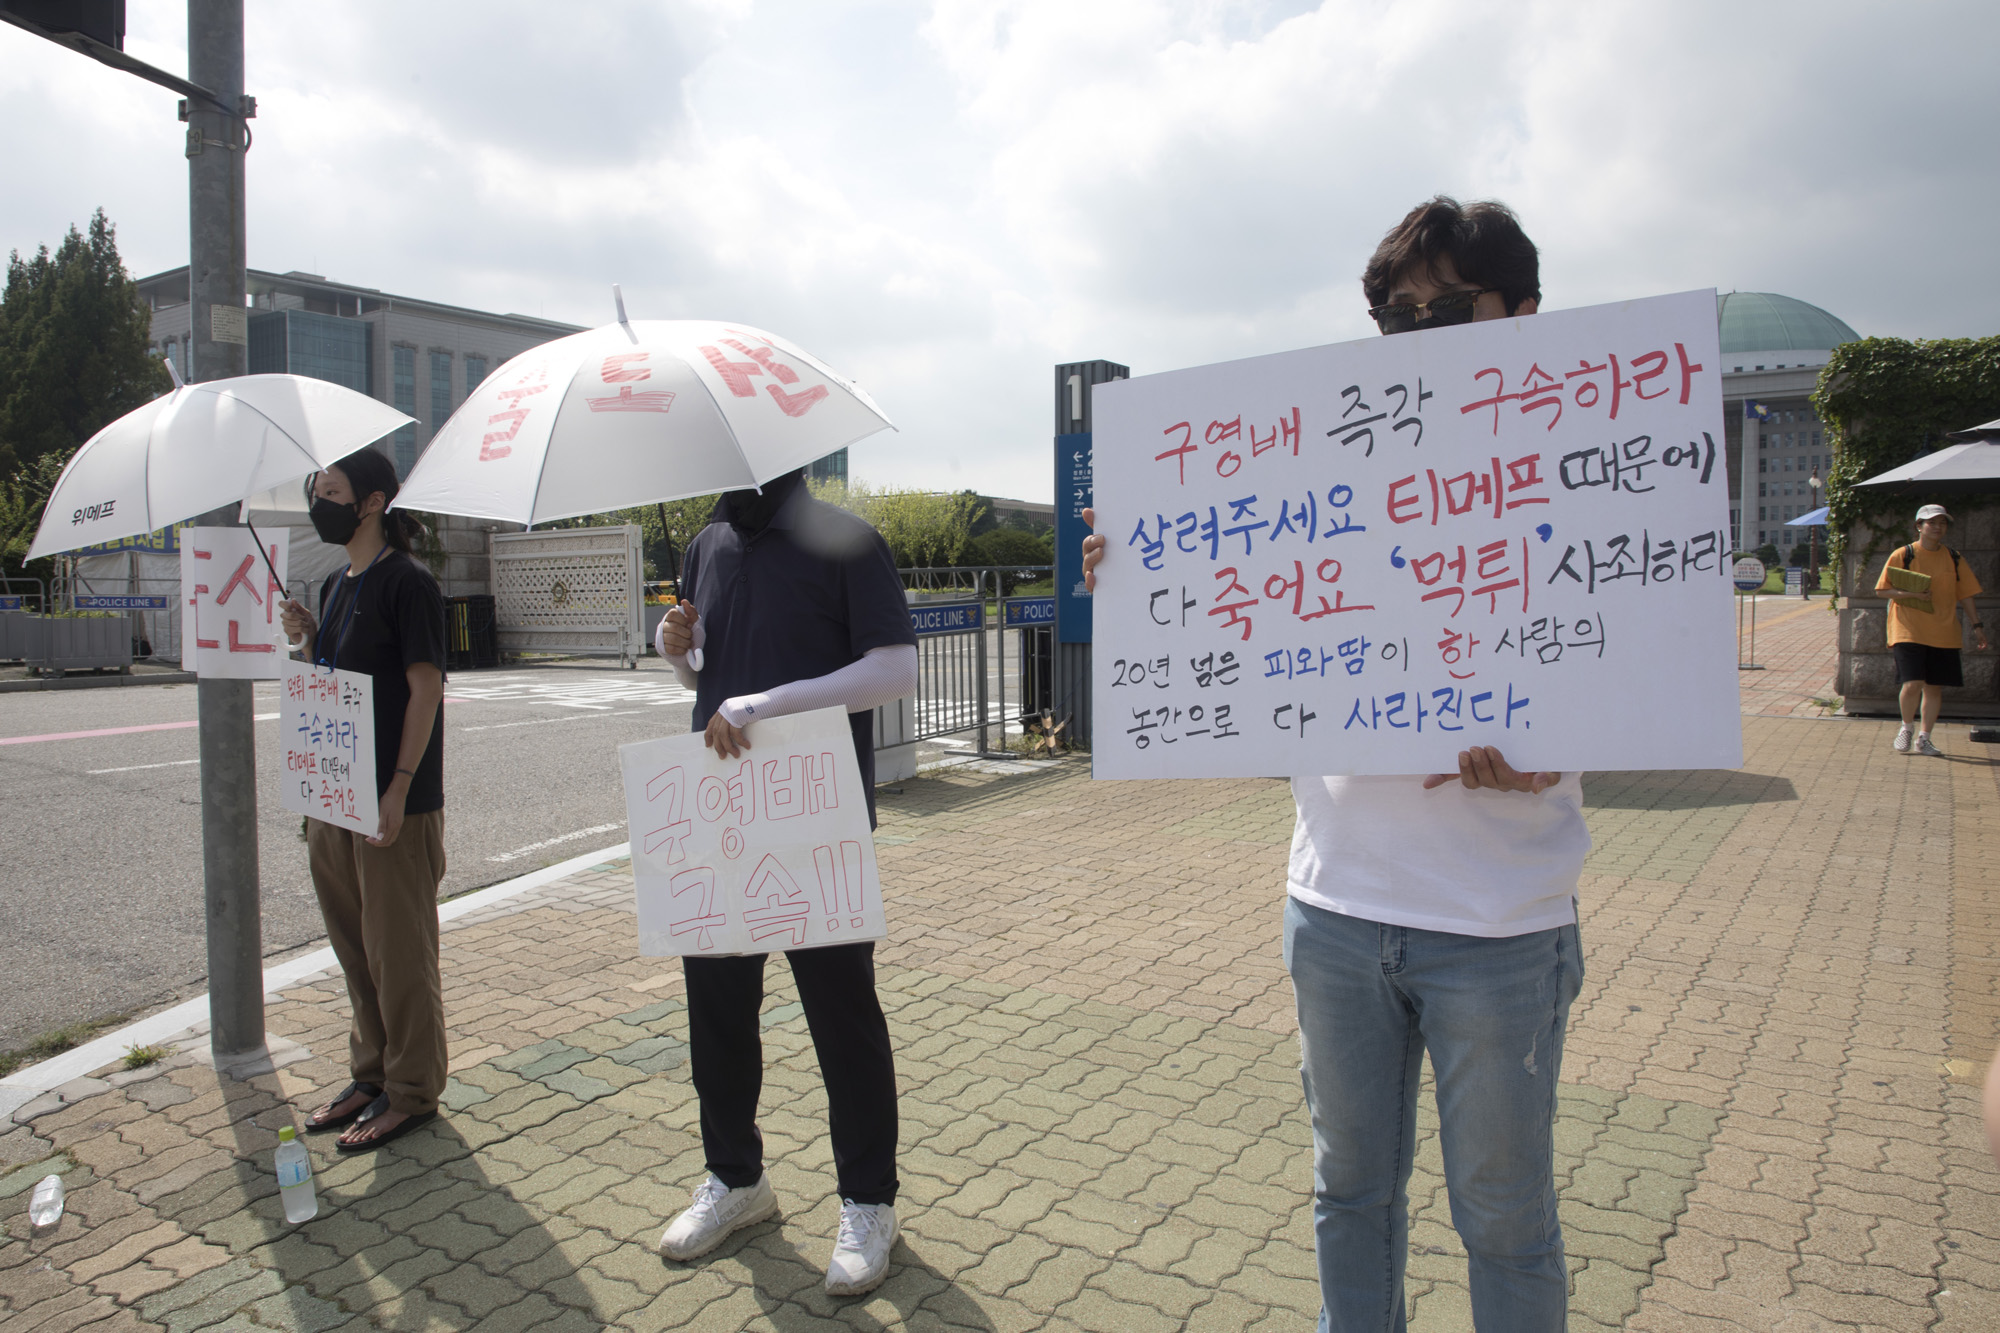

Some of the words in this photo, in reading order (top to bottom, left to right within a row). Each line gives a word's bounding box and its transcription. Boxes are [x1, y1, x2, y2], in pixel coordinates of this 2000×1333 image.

[1066, 374, 1082, 420] 1
[1155, 407, 1301, 486] 구영배
[1326, 376, 1433, 458] 즉각
[1460, 342, 1703, 437] 구속하라
[72, 500, 117, 526] 위메프
[1128, 484, 1366, 571] 살려주세요
[1387, 453, 1550, 526] 티메프
[1559, 431, 1716, 493] 때문에
[92, 598, 127, 607] POLICE
[130, 598, 150, 607] LINE
[1150, 585, 1197, 628] 다
[1207, 558, 1375, 641] 죽어요
[1547, 528, 1732, 594] 사죄하라
[910, 612, 941, 629] OLICE
[944, 610, 964, 627] LINE
[1024, 604, 1055, 619] POLIC
[1111, 653, 1170, 689] 20년
[1190, 651, 1240, 688] 넘은
[1437, 627, 1480, 679] 한
[1494, 611, 1605, 664] 사람의
[287, 674, 305, 702] 먹튀
[308, 673, 339, 706] 구영배
[343, 681, 363, 714] 즉각
[1127, 704, 1240, 750] 농간으로
[1273, 703, 1316, 738] 다
[1344, 682, 1530, 733] 사라진다.
[297, 712, 359, 763] 구속하라
[287, 750, 319, 776] 티메프
[321, 757, 350, 782] 때문에
[301, 780, 314, 804] 다
[319, 779, 362, 822] 죽어요
[644, 752, 839, 865] 구영배
